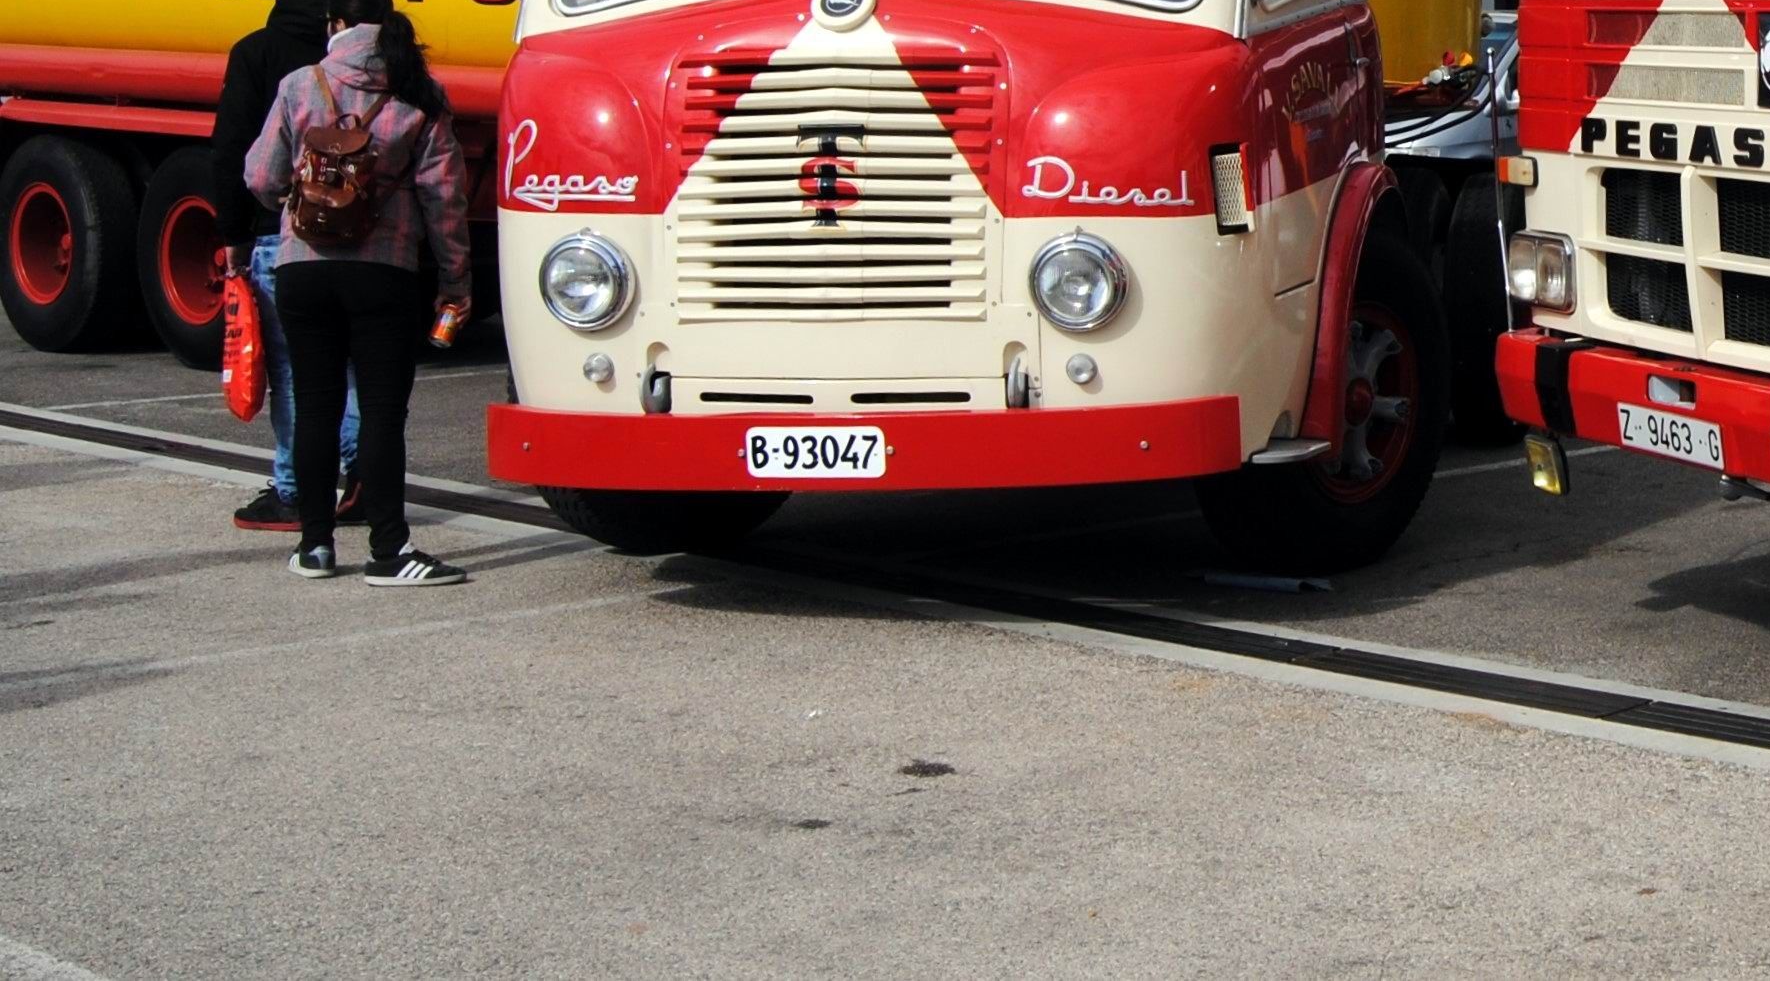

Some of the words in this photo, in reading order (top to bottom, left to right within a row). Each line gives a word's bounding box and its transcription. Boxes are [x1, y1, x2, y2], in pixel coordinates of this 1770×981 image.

[504, 119, 639, 212] Pegaso
[1021, 155, 1196, 207] Diesel
[750, 432, 879, 471] B-93047
